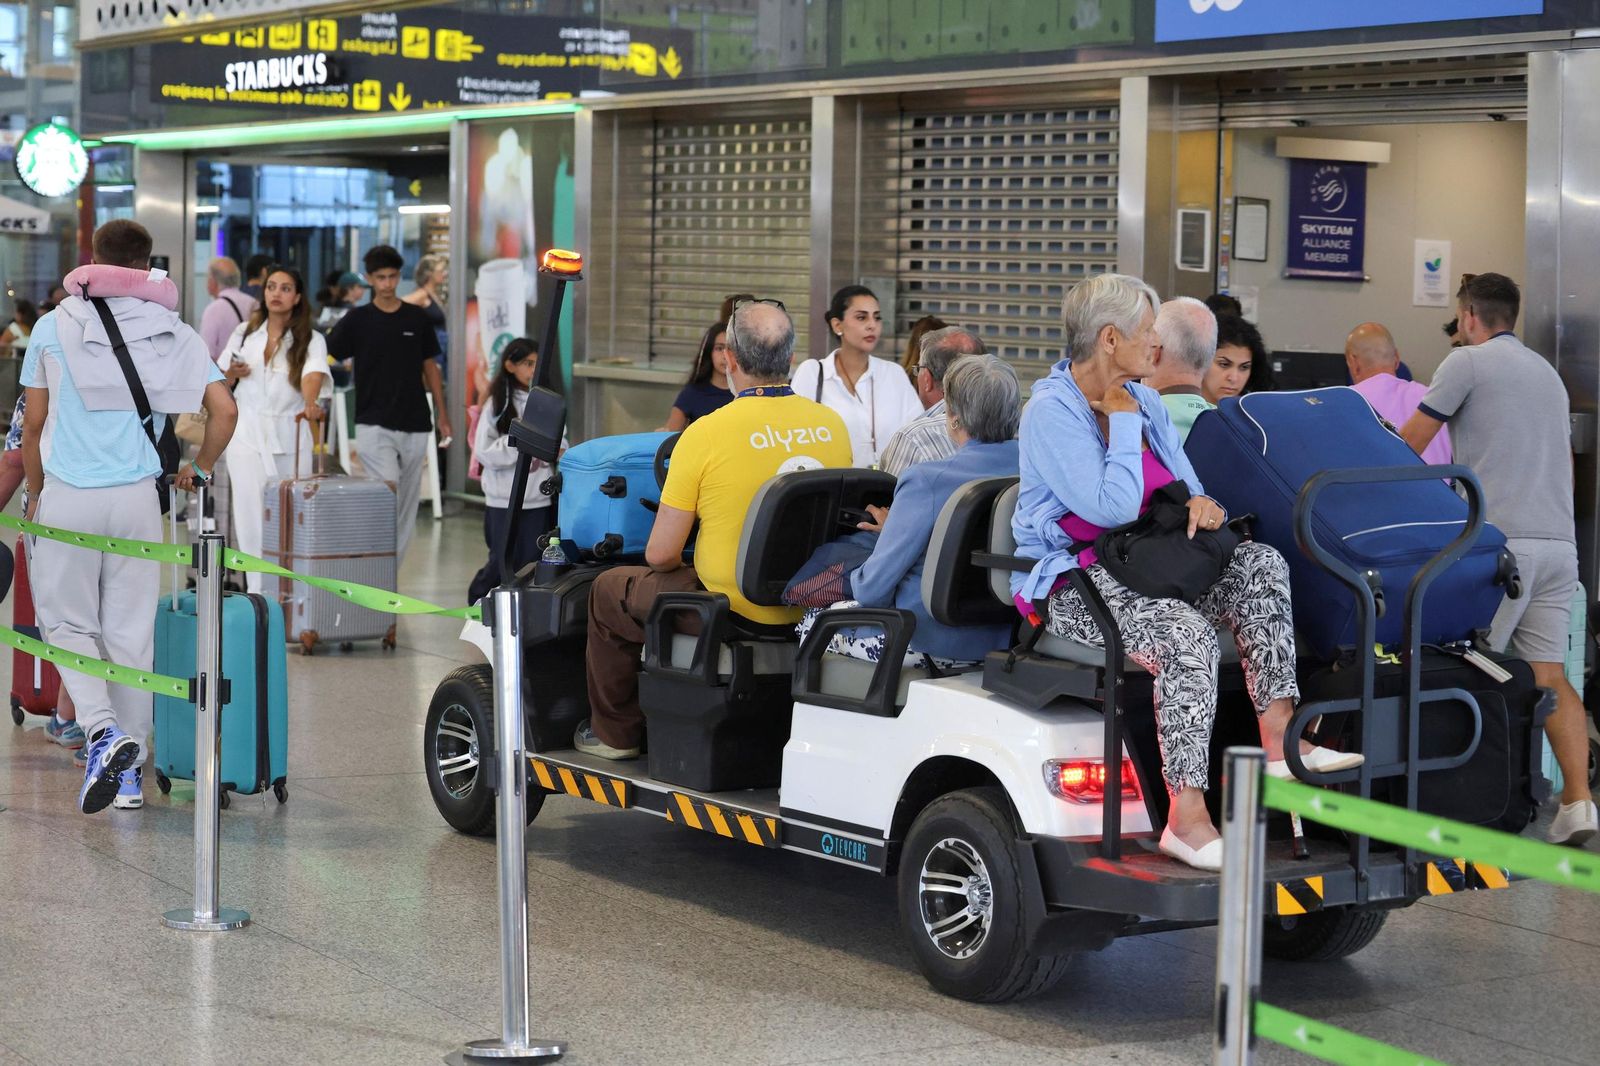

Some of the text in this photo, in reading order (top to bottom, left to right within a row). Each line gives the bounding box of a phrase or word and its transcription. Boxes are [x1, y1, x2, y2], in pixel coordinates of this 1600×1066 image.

[225, 52, 328, 93] STARBUCKS
[1301, 223, 1353, 236] SKYTEAM
[1302, 238, 1351, 250] ALLIANCE
[1304, 252, 1349, 263] MEMBER
[750, 425, 832, 453] alyzia
[835, 837, 867, 861] TEYCARS
